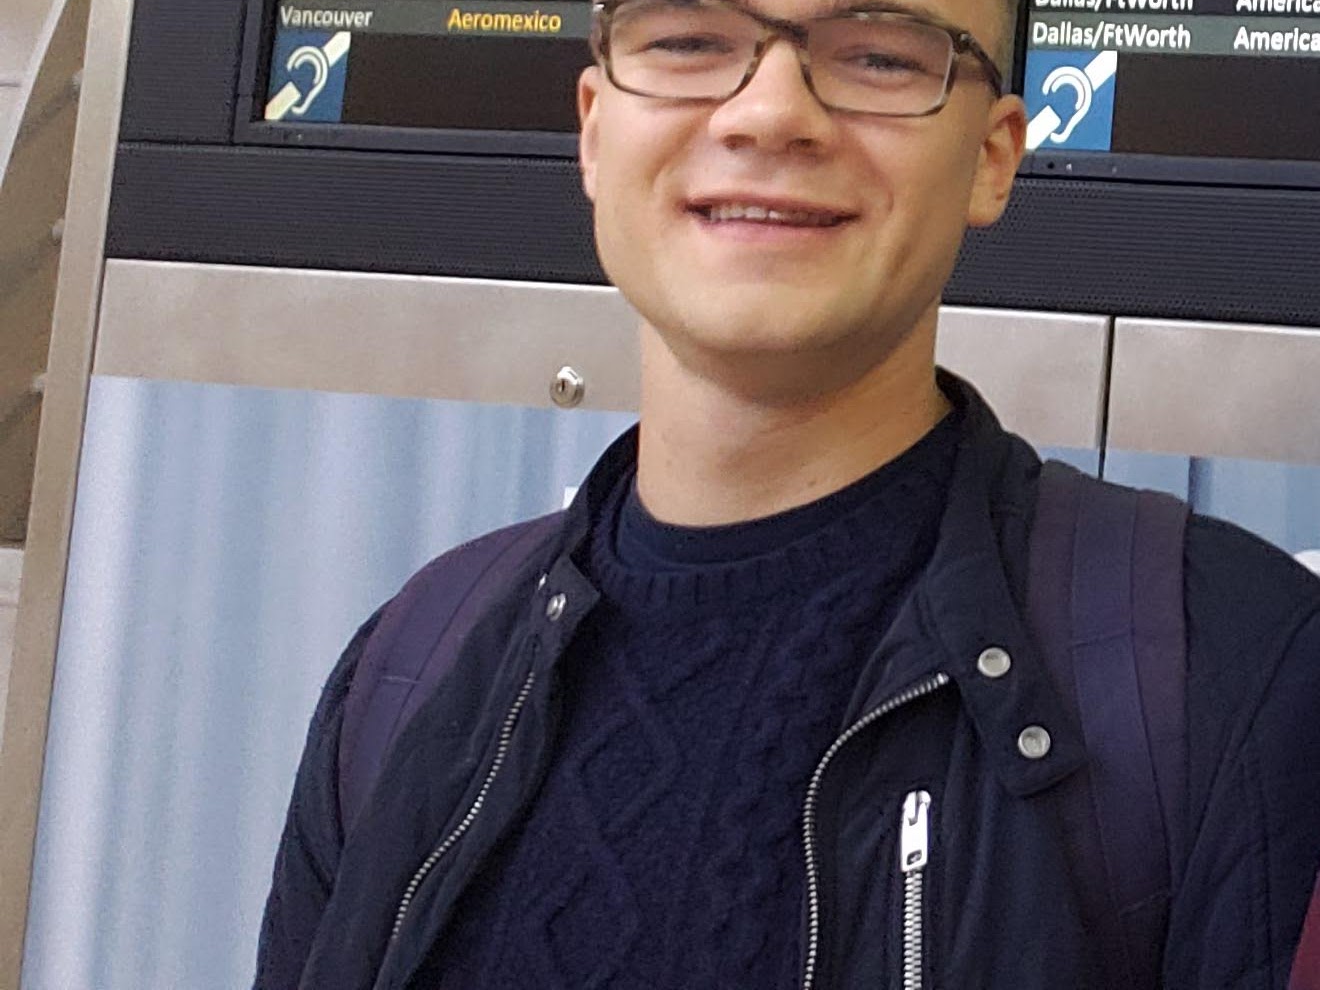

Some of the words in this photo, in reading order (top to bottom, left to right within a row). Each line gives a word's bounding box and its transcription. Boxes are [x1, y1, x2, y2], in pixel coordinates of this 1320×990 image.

[280, 6, 373, 28] Vancouver
[447, 9, 562, 33] Aeromexico
[1033, 22, 1191, 49] Dallas/FtWorth
